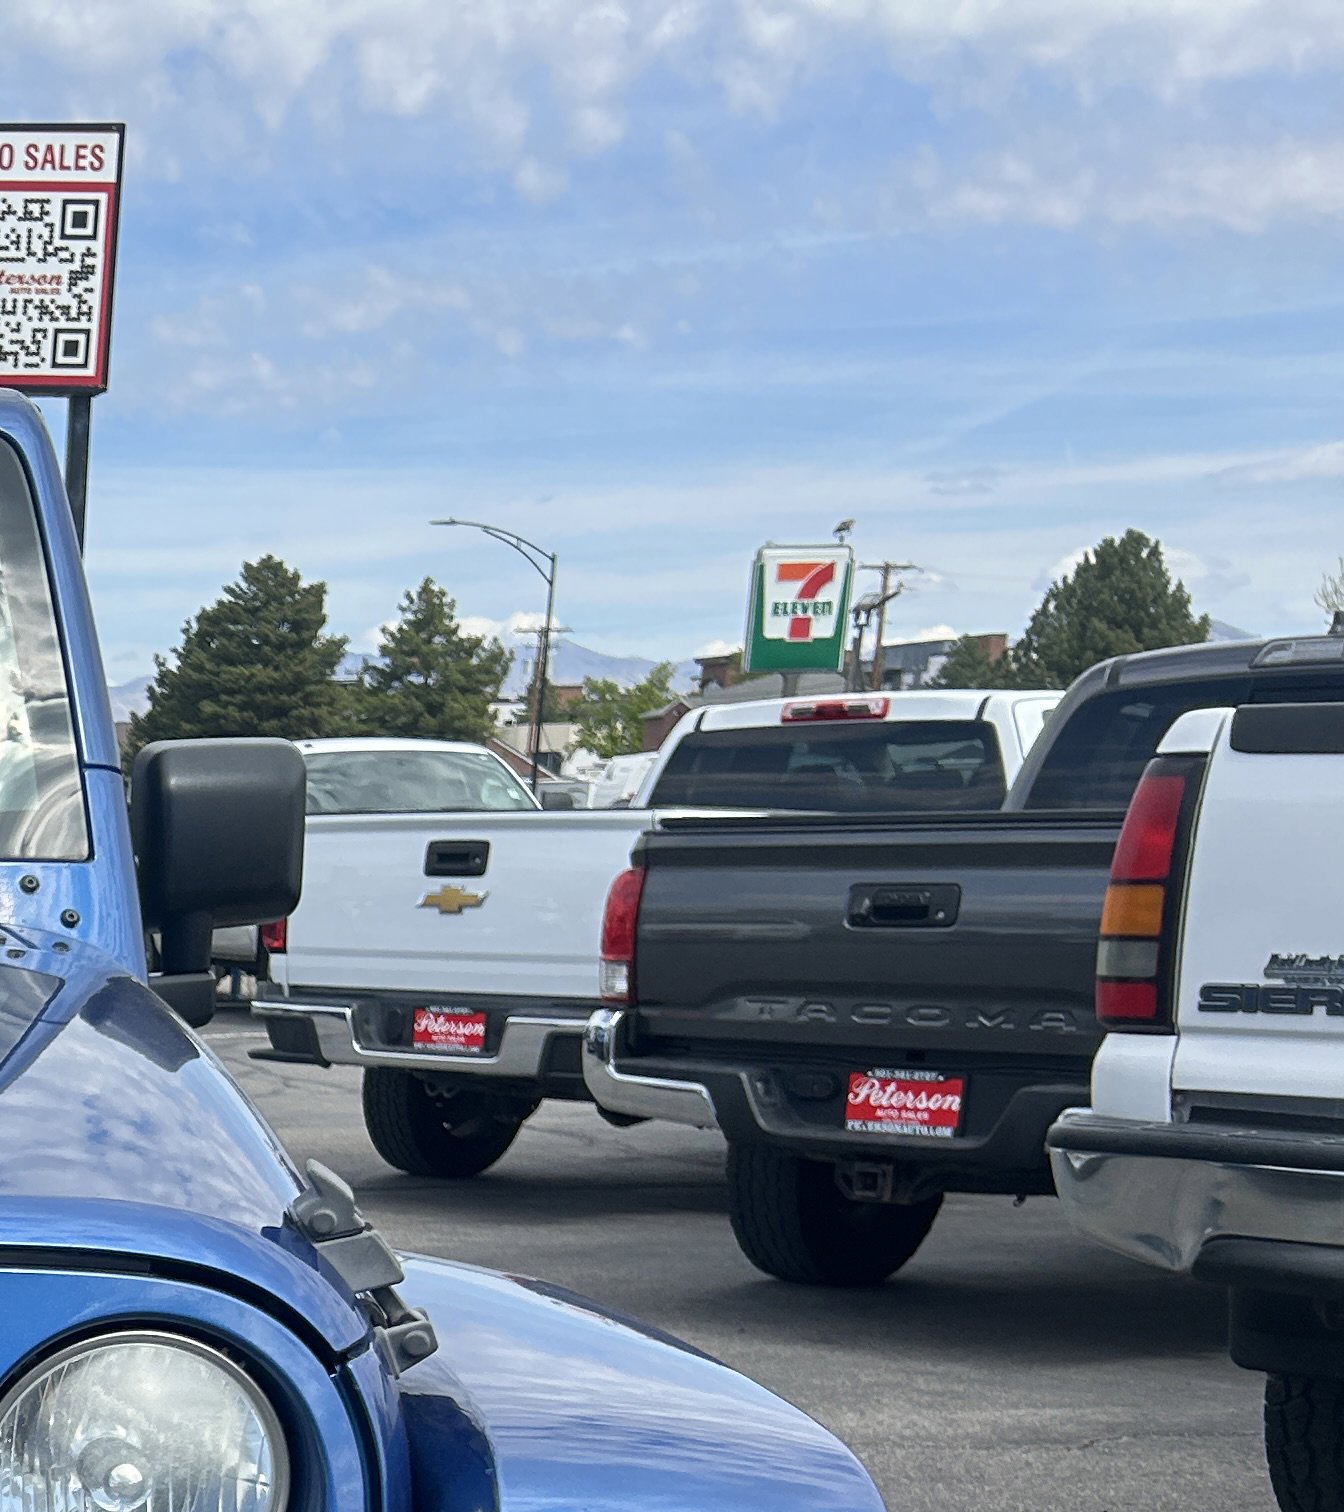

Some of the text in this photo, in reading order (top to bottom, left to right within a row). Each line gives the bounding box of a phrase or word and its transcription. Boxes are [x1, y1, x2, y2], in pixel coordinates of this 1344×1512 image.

[23, 144, 105, 172] SALES
[744, 998, 1078, 1032] TACOMA
[848, 1077, 961, 1112] Peterson
